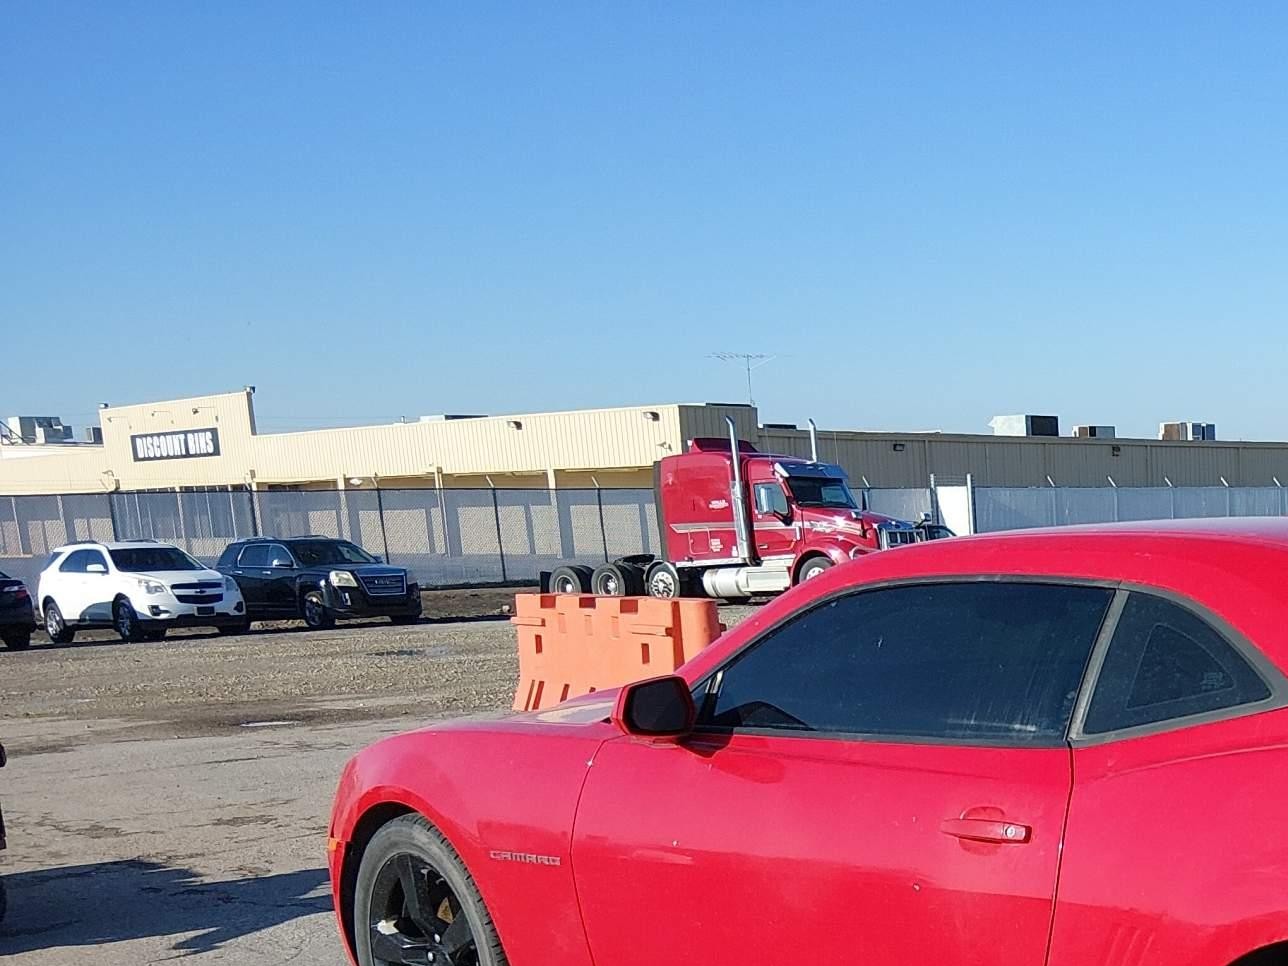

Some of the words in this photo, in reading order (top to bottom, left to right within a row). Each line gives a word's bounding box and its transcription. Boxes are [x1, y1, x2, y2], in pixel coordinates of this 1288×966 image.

[136, 433, 186, 458] DISCOUNT
[186, 431, 215, 454] BINS
[489, 850, 561, 866] CAMARO
